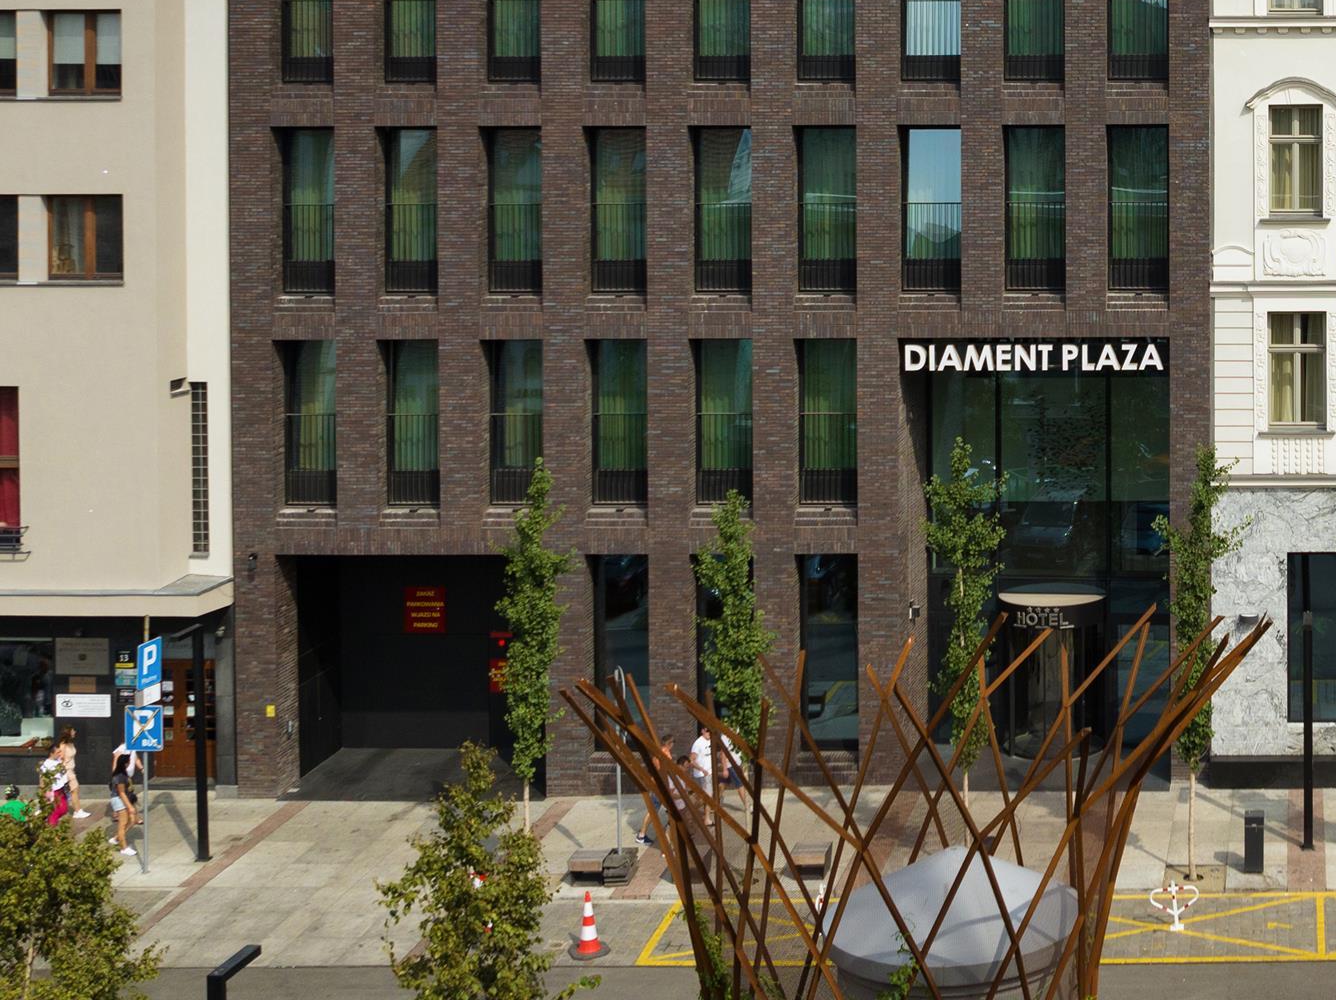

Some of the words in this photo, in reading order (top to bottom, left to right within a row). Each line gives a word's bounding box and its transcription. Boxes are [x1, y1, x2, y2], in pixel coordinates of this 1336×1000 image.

[904, 343, 1054, 372] DIAMENT
[1061, 343, 1165, 371] PLAZA
[1016, 611, 1069, 626] HOTEL
[142, 643, 157, 675] P
